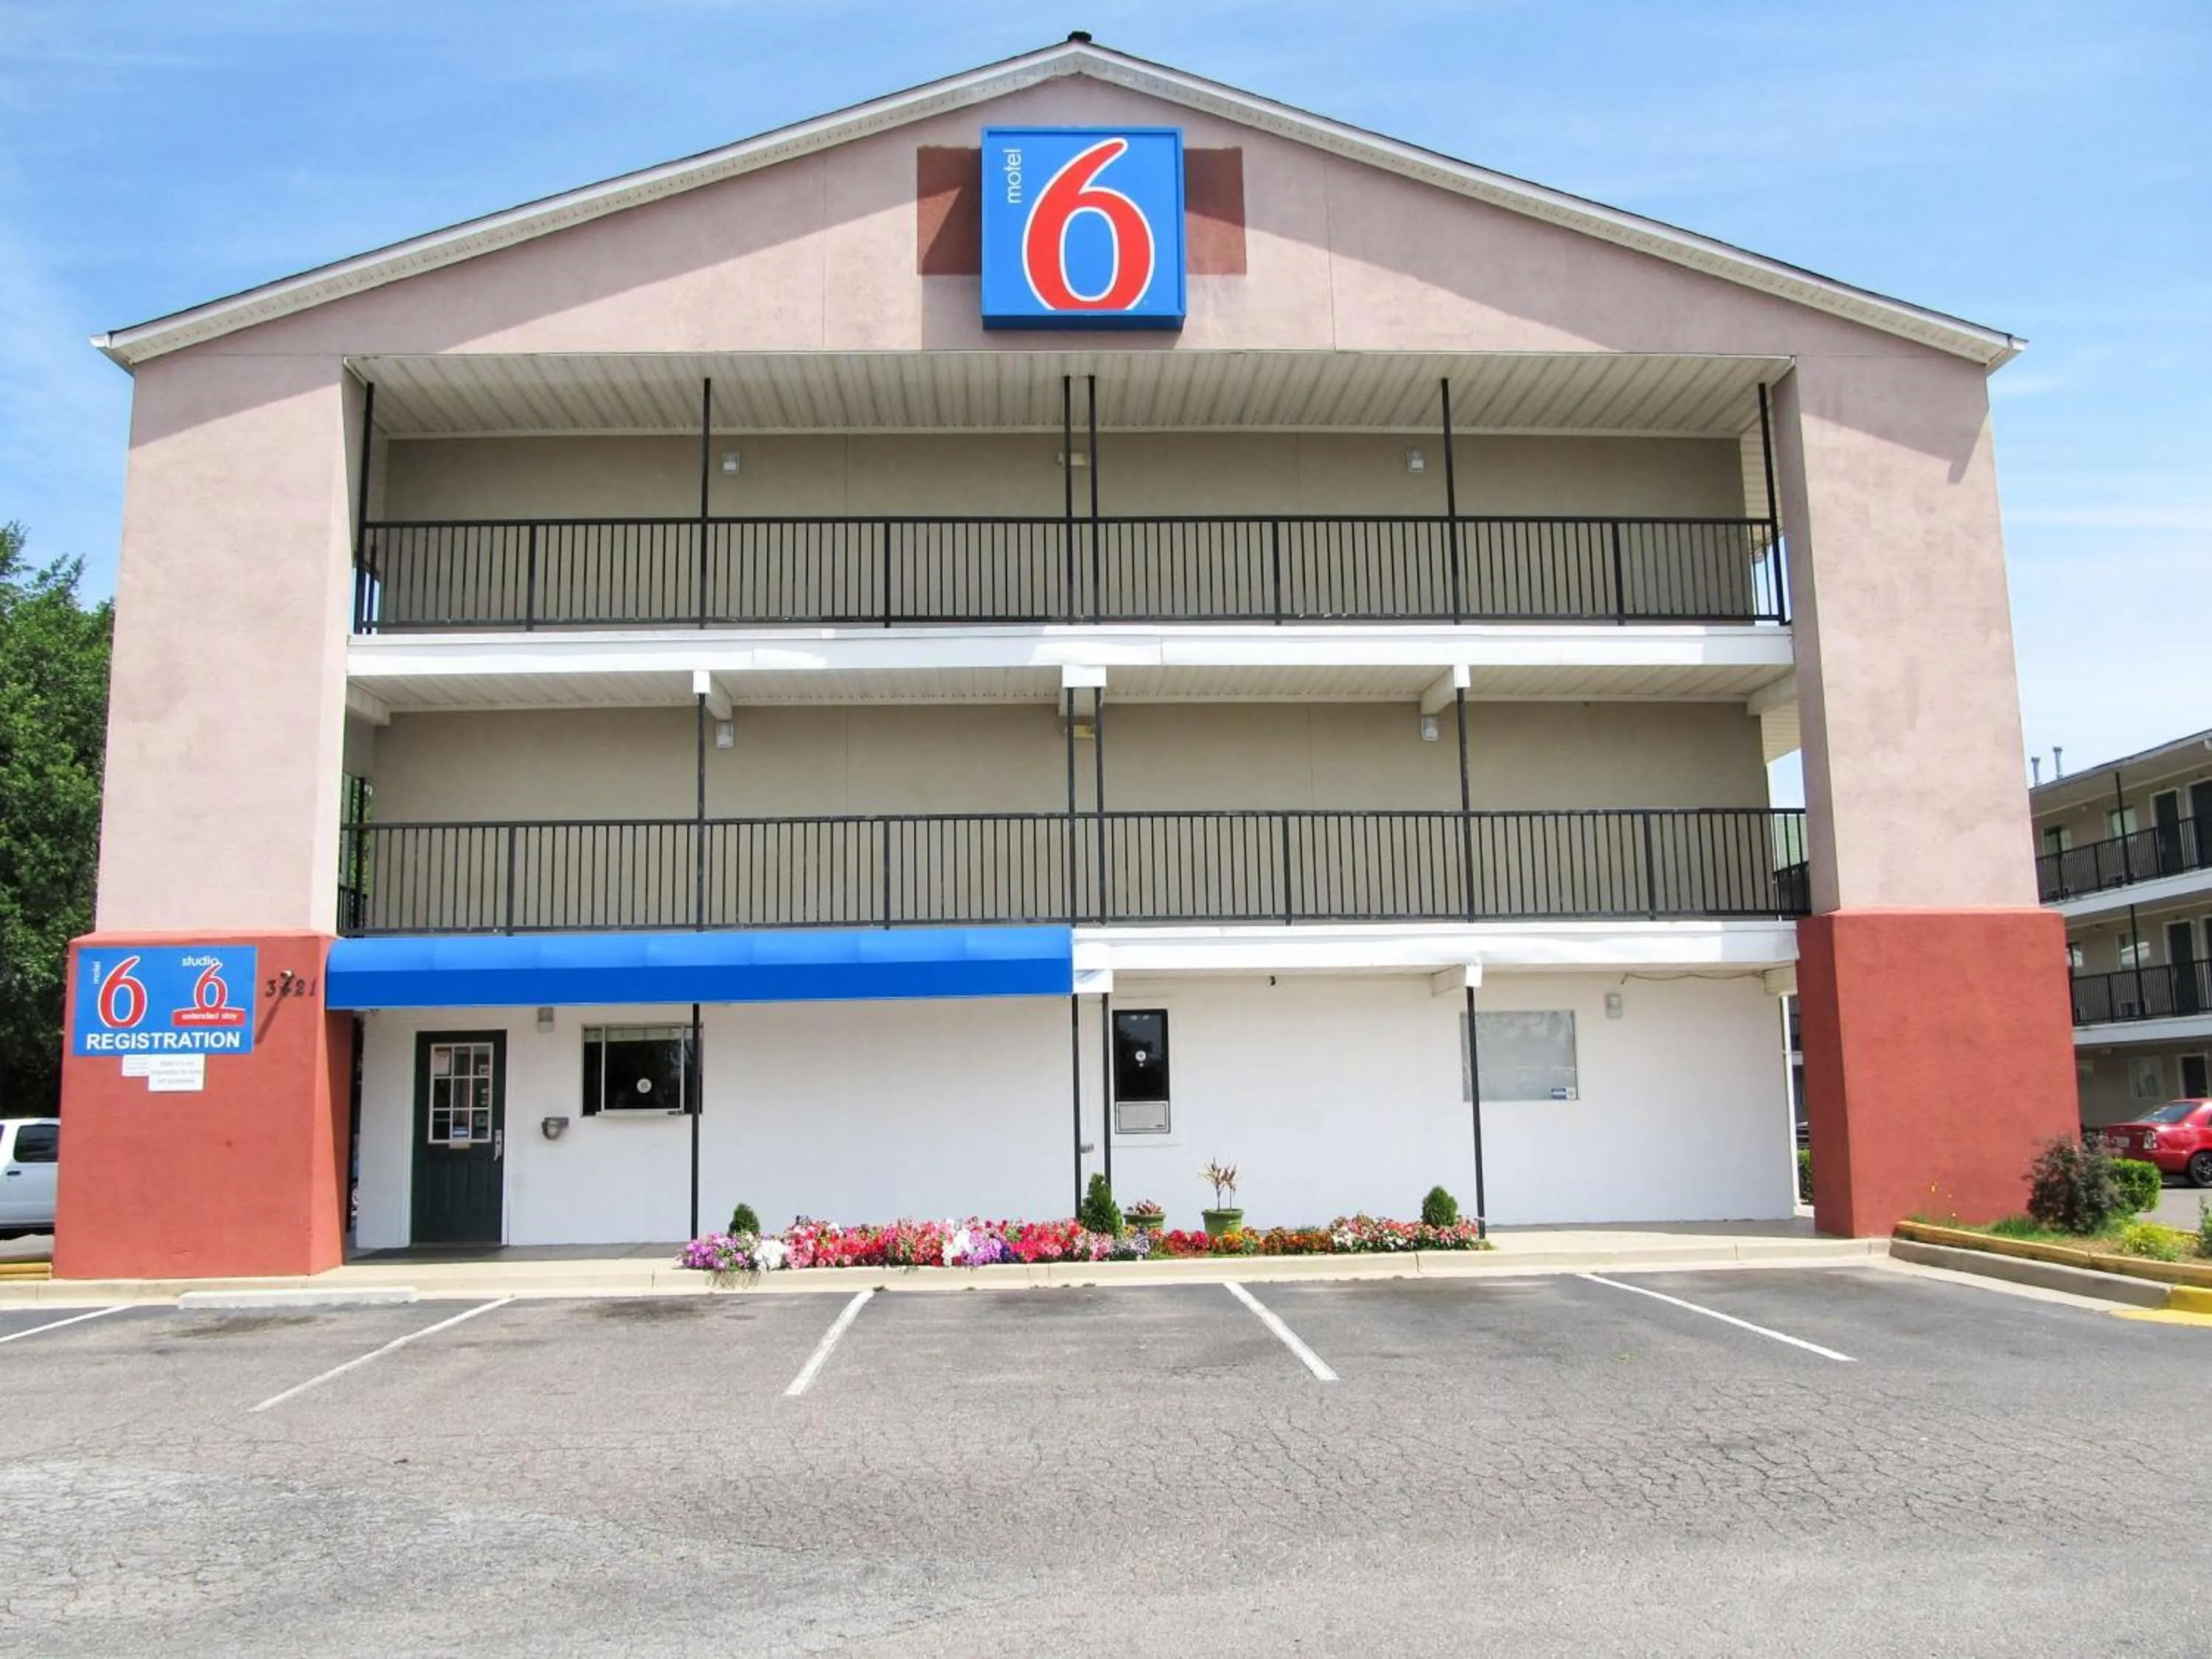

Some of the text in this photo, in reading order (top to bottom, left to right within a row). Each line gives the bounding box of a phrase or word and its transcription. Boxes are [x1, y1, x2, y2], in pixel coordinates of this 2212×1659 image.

[1003, 137, 1155, 310] motel 6
[181, 956, 220, 967] studio
[193, 961, 228, 1009] 6
[97, 956, 147, 1028] 6
[86, 1032, 240, 1050] REGISTRATION
